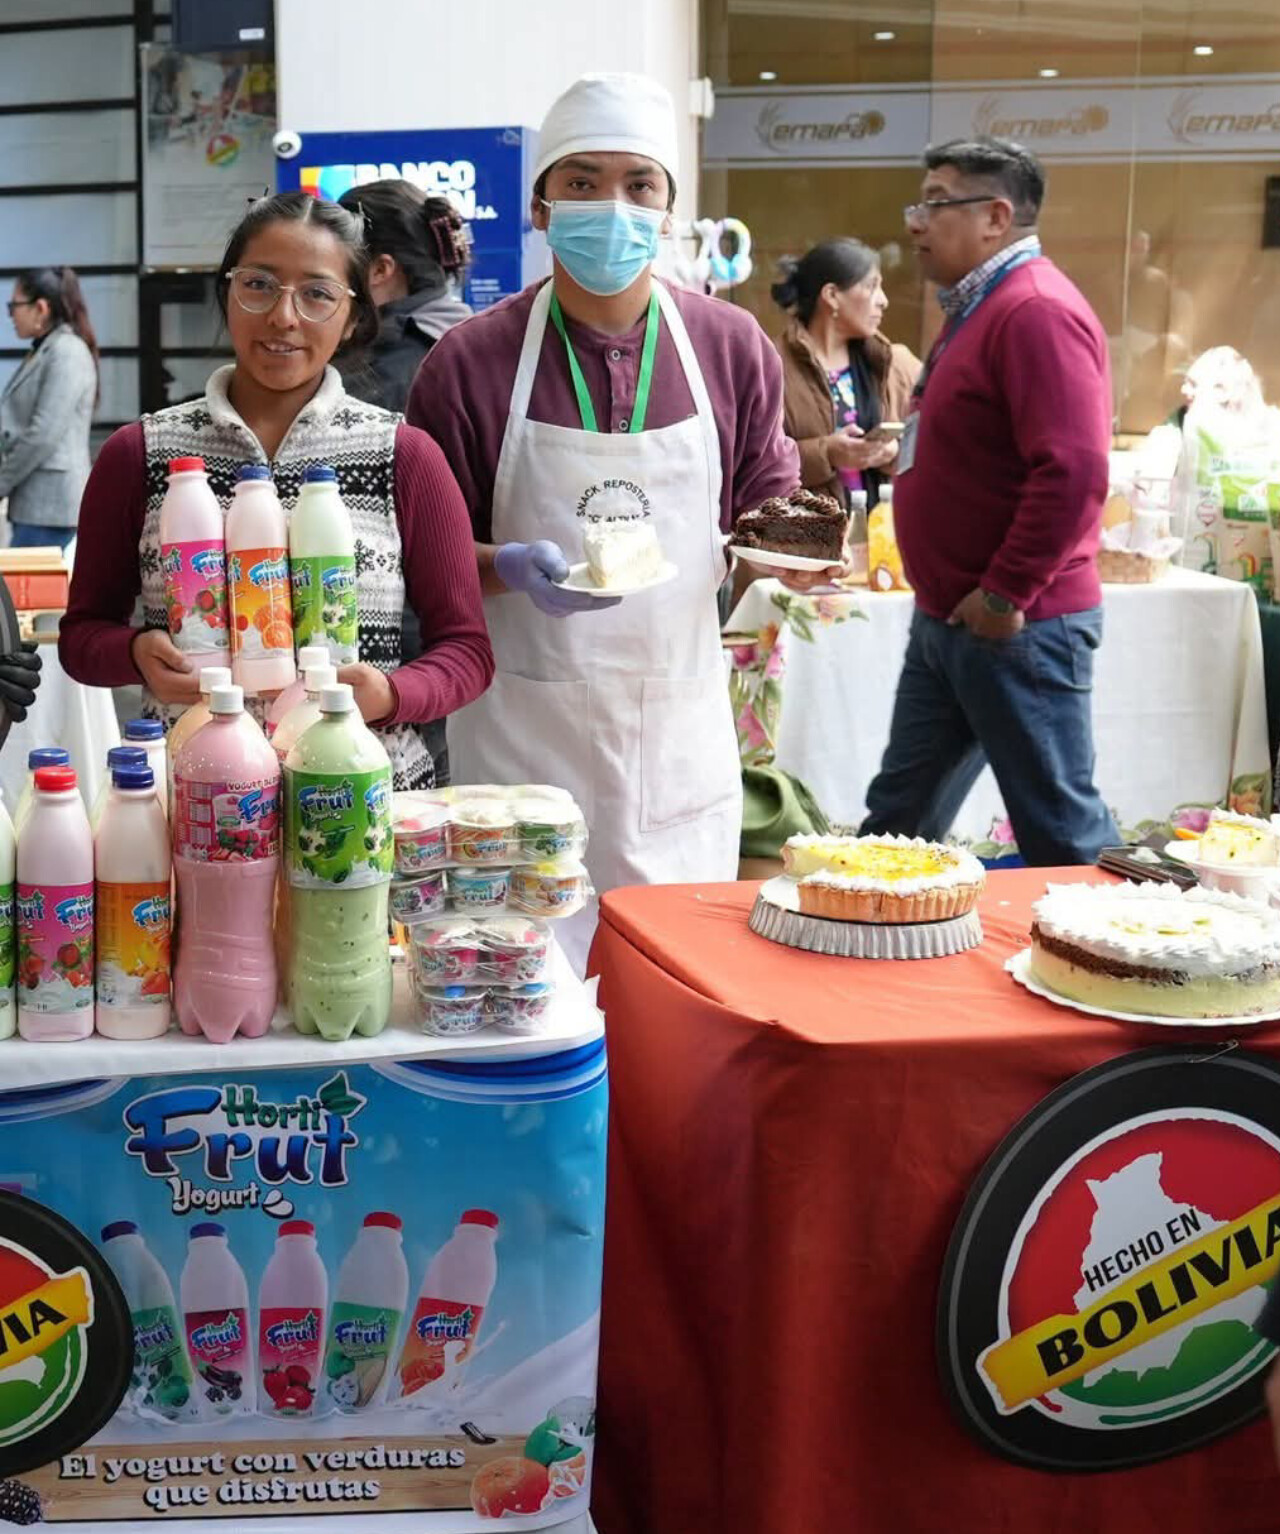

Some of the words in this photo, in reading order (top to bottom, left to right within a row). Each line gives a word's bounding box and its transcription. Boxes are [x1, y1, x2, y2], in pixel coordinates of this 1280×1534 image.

[356, 160, 475, 191] BANCO
[576, 485, 600, 517] SNACK
[322, 566, 355, 589] Fru
[299, 786, 353, 812] Frut
[220, 1084, 322, 1131] Horti
[124, 1086, 358, 1185] Frut
[167, 1176, 260, 1215] Yogurt
[1084, 1230, 1166, 1293] HECHO
[1165, 1208, 1202, 1245] EN
[191, 1326, 242, 1348] Frut
[267, 1323, 318, 1347] Frut
[334, 1321, 387, 1344] Frut
[417, 1316, 469, 1338] Frut
[60, 1455, 97, 1479] El
[105, 1452, 222, 1482] yogurt
[234, 1450, 298, 1473] con
[305, 1443, 466, 1470] verduras
[144, 1482, 209, 1512] que
[217, 1475, 382, 1503] disfrutas
